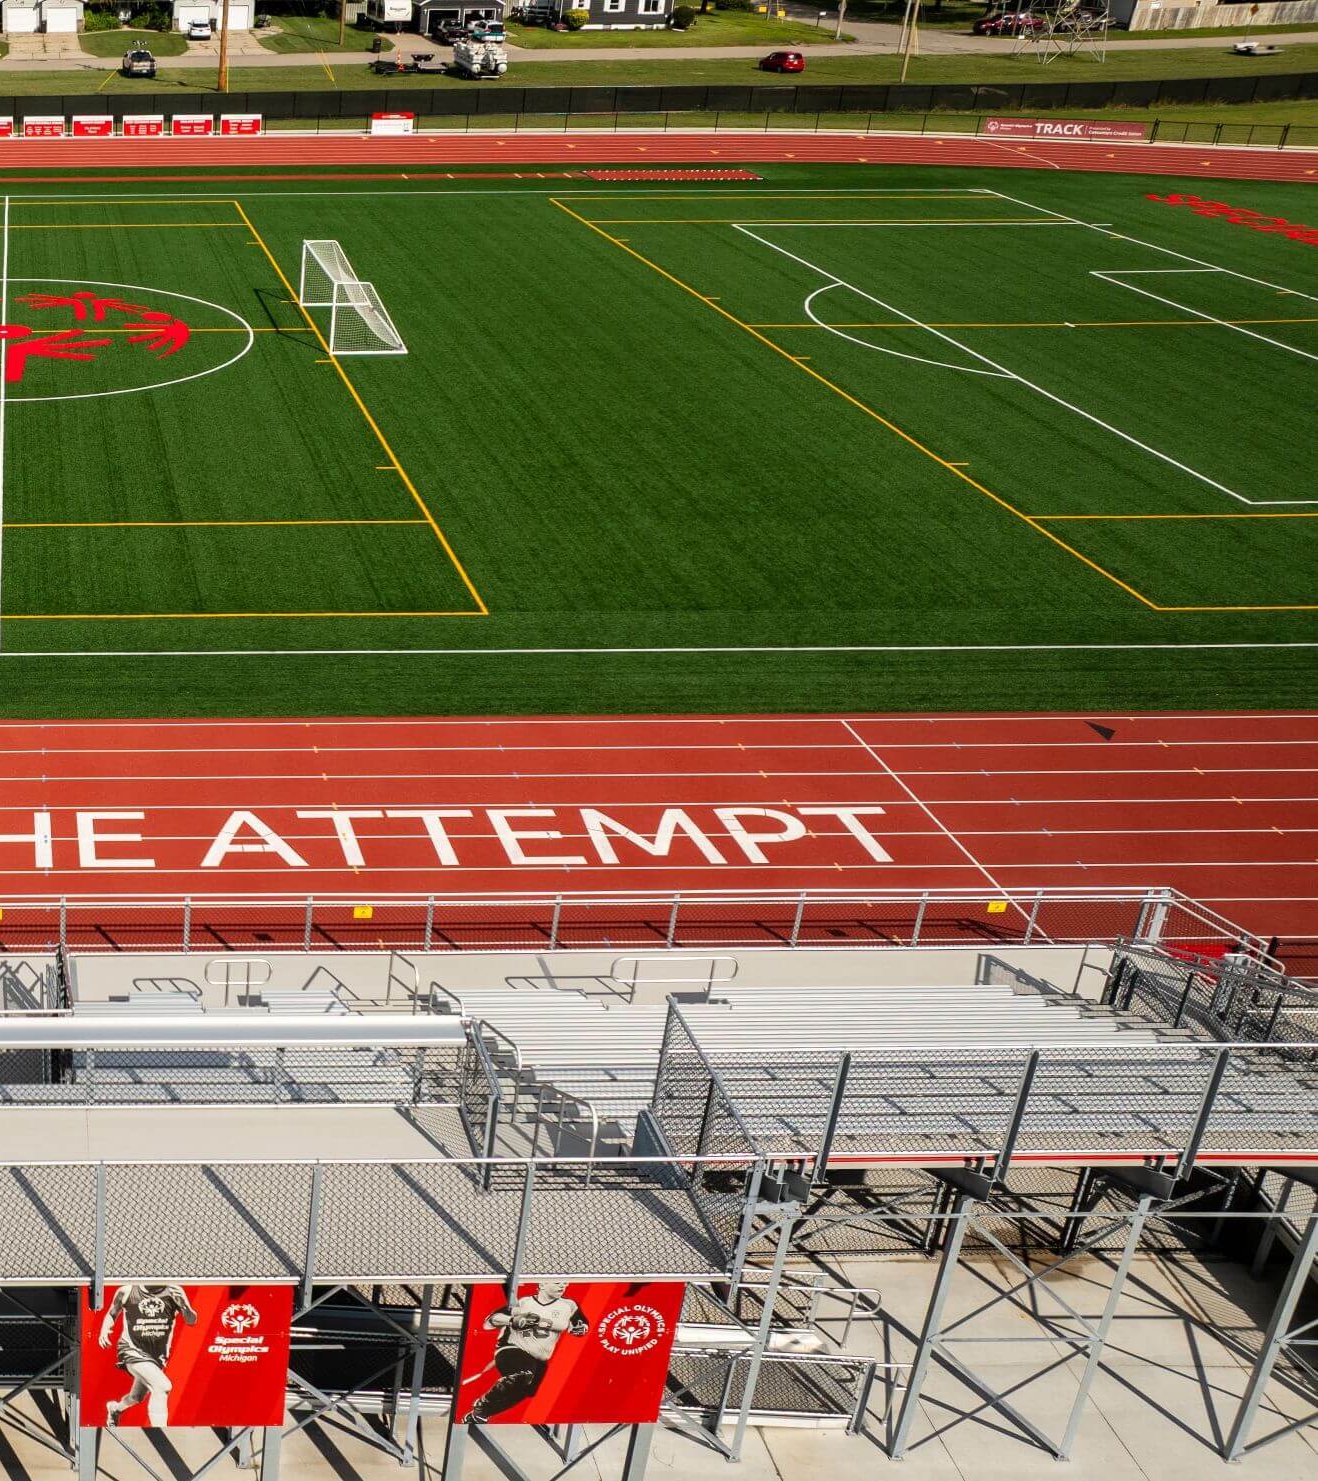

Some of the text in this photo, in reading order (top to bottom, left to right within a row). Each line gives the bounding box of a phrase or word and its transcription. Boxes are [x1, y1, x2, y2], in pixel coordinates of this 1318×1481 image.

[1035, 122, 1084, 136] TRACK
[200, 807, 894, 867] ATTEMPT
[598, 1304, 666, 1333] SPECIAL OLYMPICS
[215, 1336, 264, 1345] Special
[600, 1339, 658, 1355] PLAY UNIFIED
[208, 1345, 269, 1354] Olympics
[218, 1354, 258, 1363] Michigan
